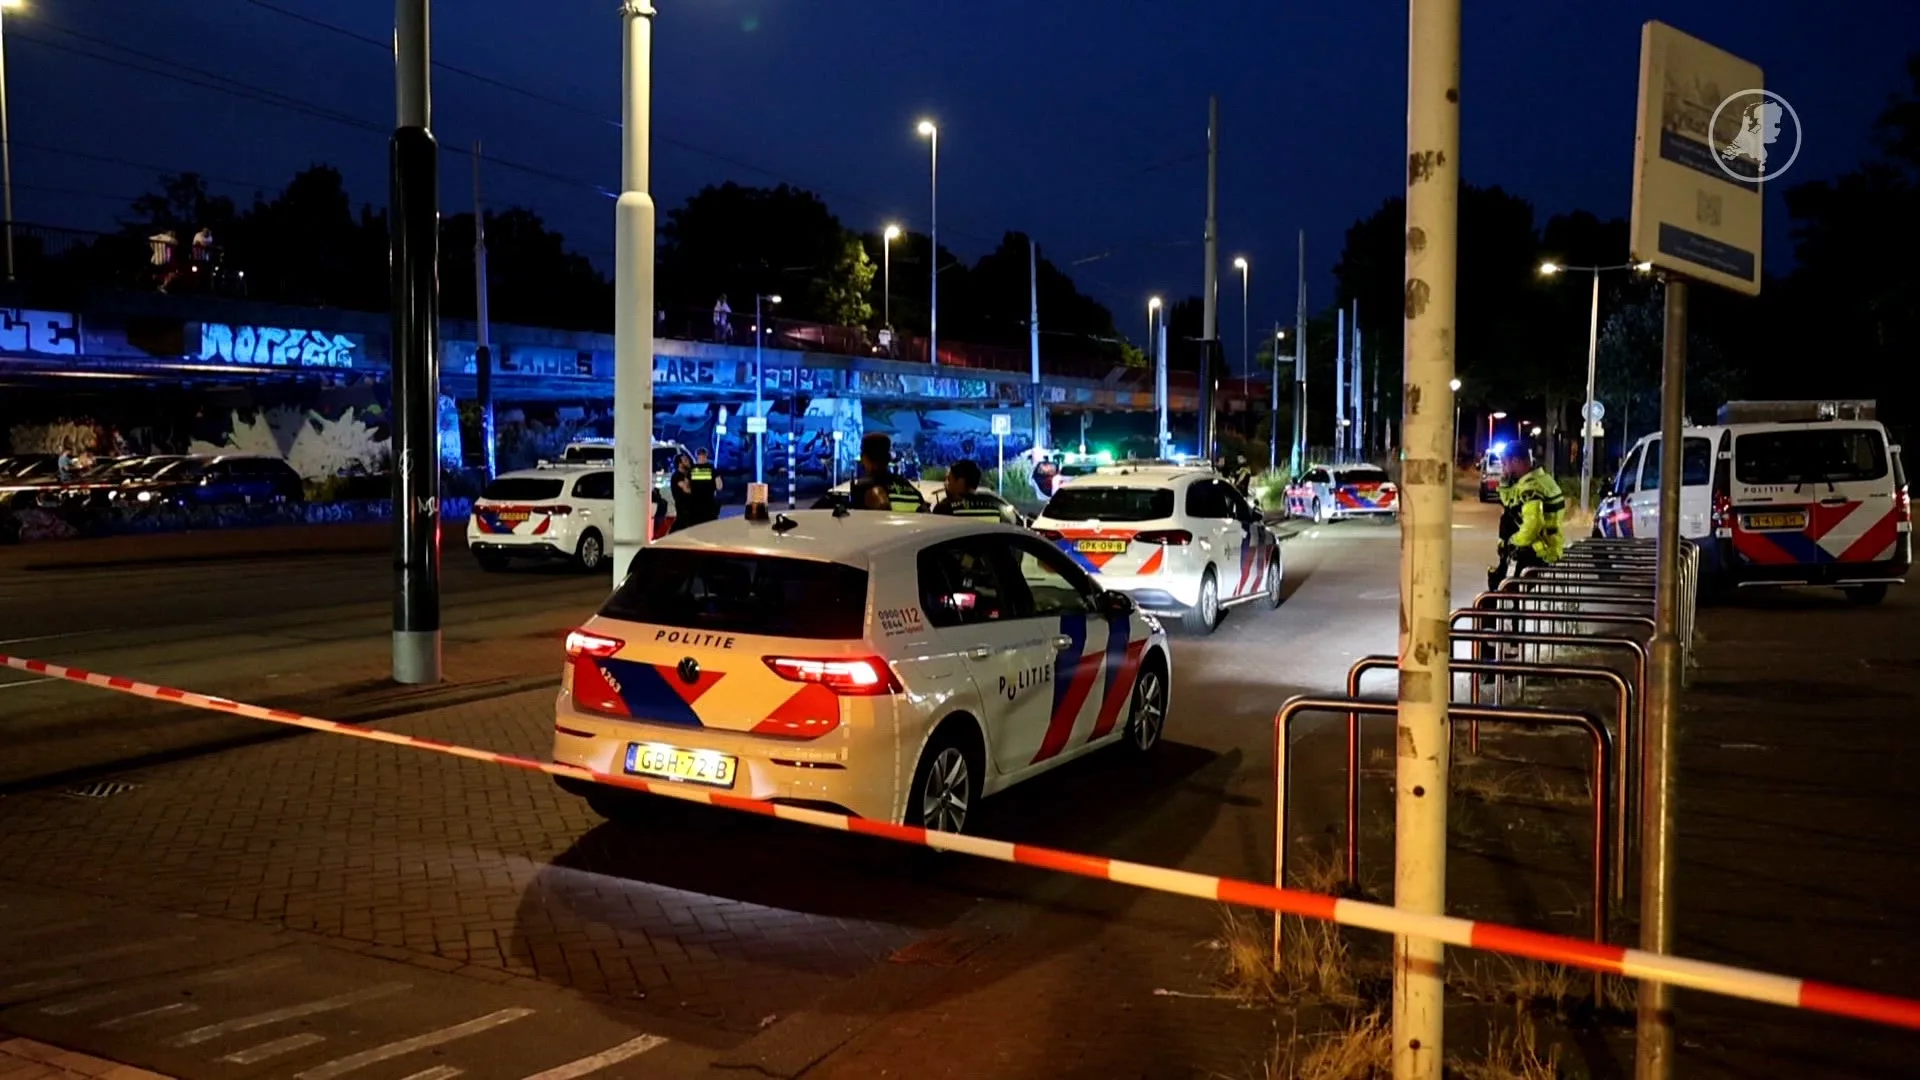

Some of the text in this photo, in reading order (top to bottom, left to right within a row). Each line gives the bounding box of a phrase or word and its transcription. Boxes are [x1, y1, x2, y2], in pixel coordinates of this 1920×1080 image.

[1744, 486, 1784, 494] POLITIE
[878, 608, 899, 620] 0900
[899, 607, 921, 624] 112
[881, 619, 903, 630] 8844
[655, 629, 736, 650] POLITIE
[999, 664, 1050, 701] POLITIE
